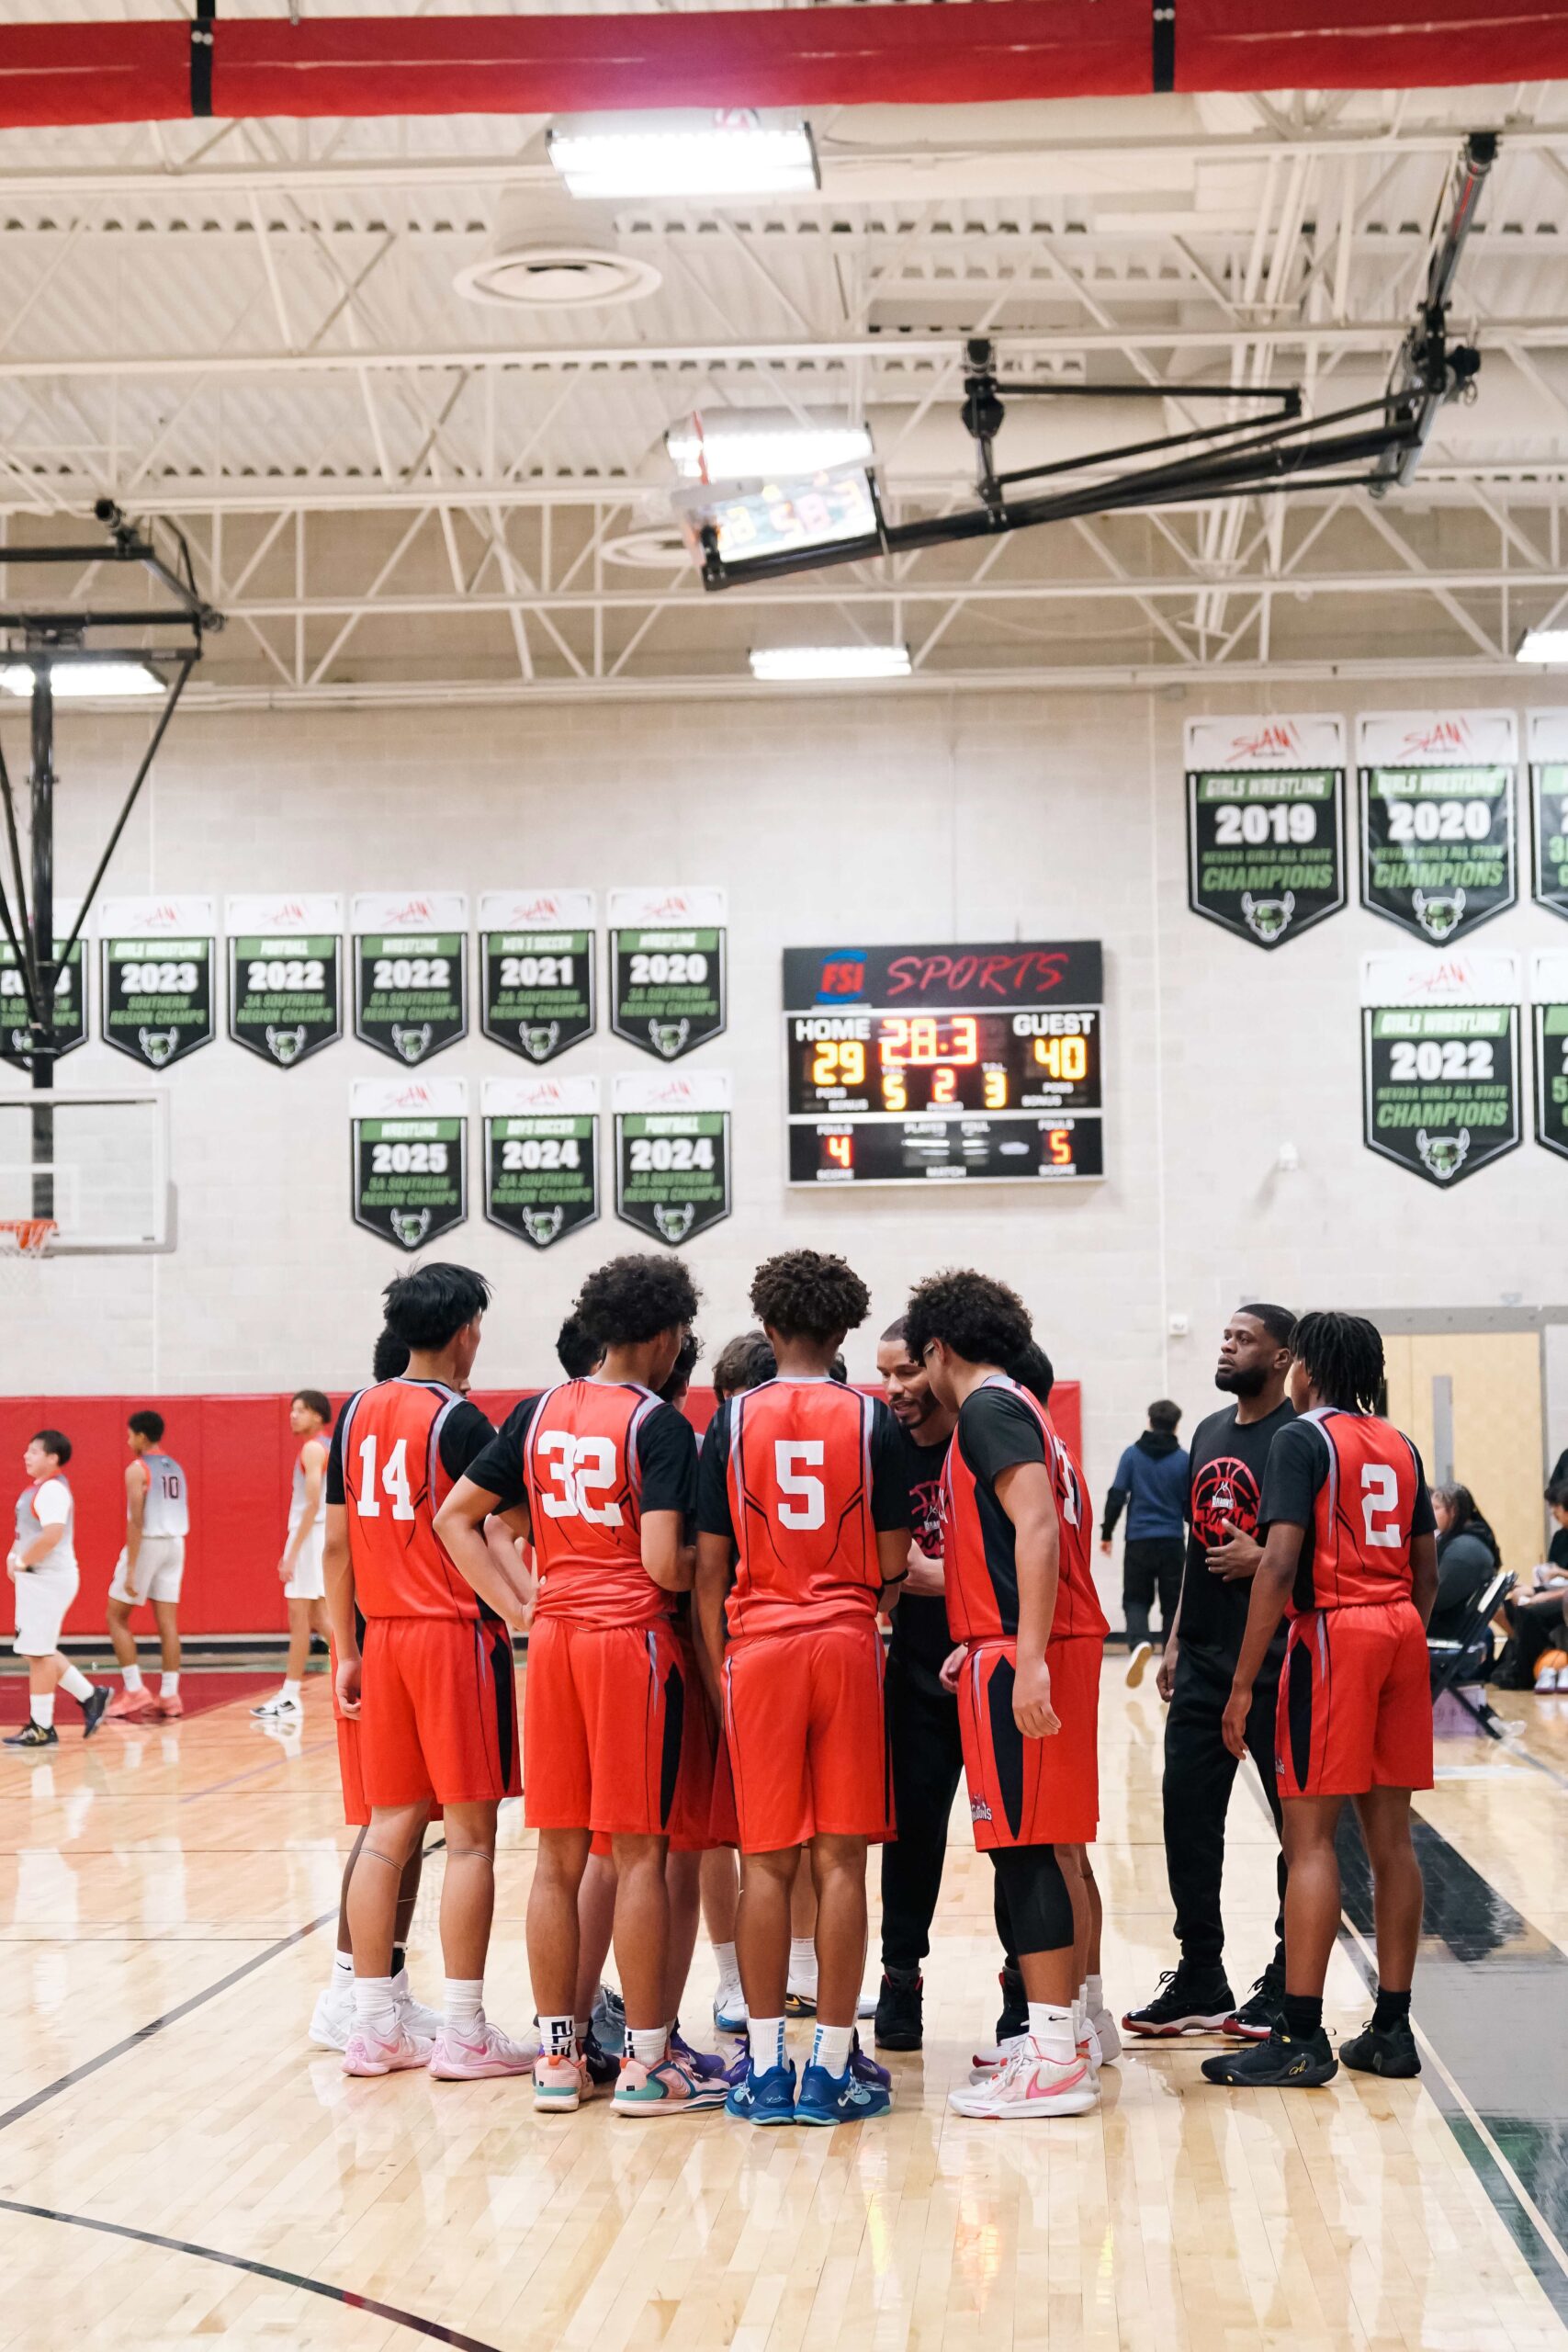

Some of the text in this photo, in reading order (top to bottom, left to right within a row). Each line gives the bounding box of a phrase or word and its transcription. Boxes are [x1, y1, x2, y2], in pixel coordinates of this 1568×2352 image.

[1214, 803, 1317, 845] 2019
[1388, 800, 1492, 841] 2020
[1202, 864, 1334, 891] CHAMPIONS
[1373, 861, 1505, 888] CHAMPIONS
[120, 961, 198, 993] 2023
[247, 959, 325, 990] 2022
[373, 957, 451, 989] 2022
[500, 956, 574, 987] 2021
[629, 953, 708, 984] 2020
[886, 952, 1069, 996] SPORTS
[795, 1017, 871, 1042] HOME
[1012, 1012, 1095, 1036] GUEST
[812, 1040, 865, 1085] 29
[1033, 1035, 1087, 1080] 40
[1389, 1040, 1495, 1080] 2022
[882, 1074, 907, 1111] 5
[932, 1067, 956, 1103] 2
[984, 1070, 1008, 1109] 3
[1377, 1102, 1508, 1128] CHAMPIONS
[372, 1142, 448, 1173] 2025
[502, 1139, 581, 1170] 2024
[629, 1137, 716, 1170] 2024
[828, 1135, 852, 1168] 4
[1049, 1129, 1071, 1164] 5
[162, 1475, 180, 1499] 10
[356, 1434, 415, 1521] 14
[537, 1430, 625, 1526] 32
[774, 1440, 826, 1531] 5
[1360, 1463, 1402, 1548] 2
